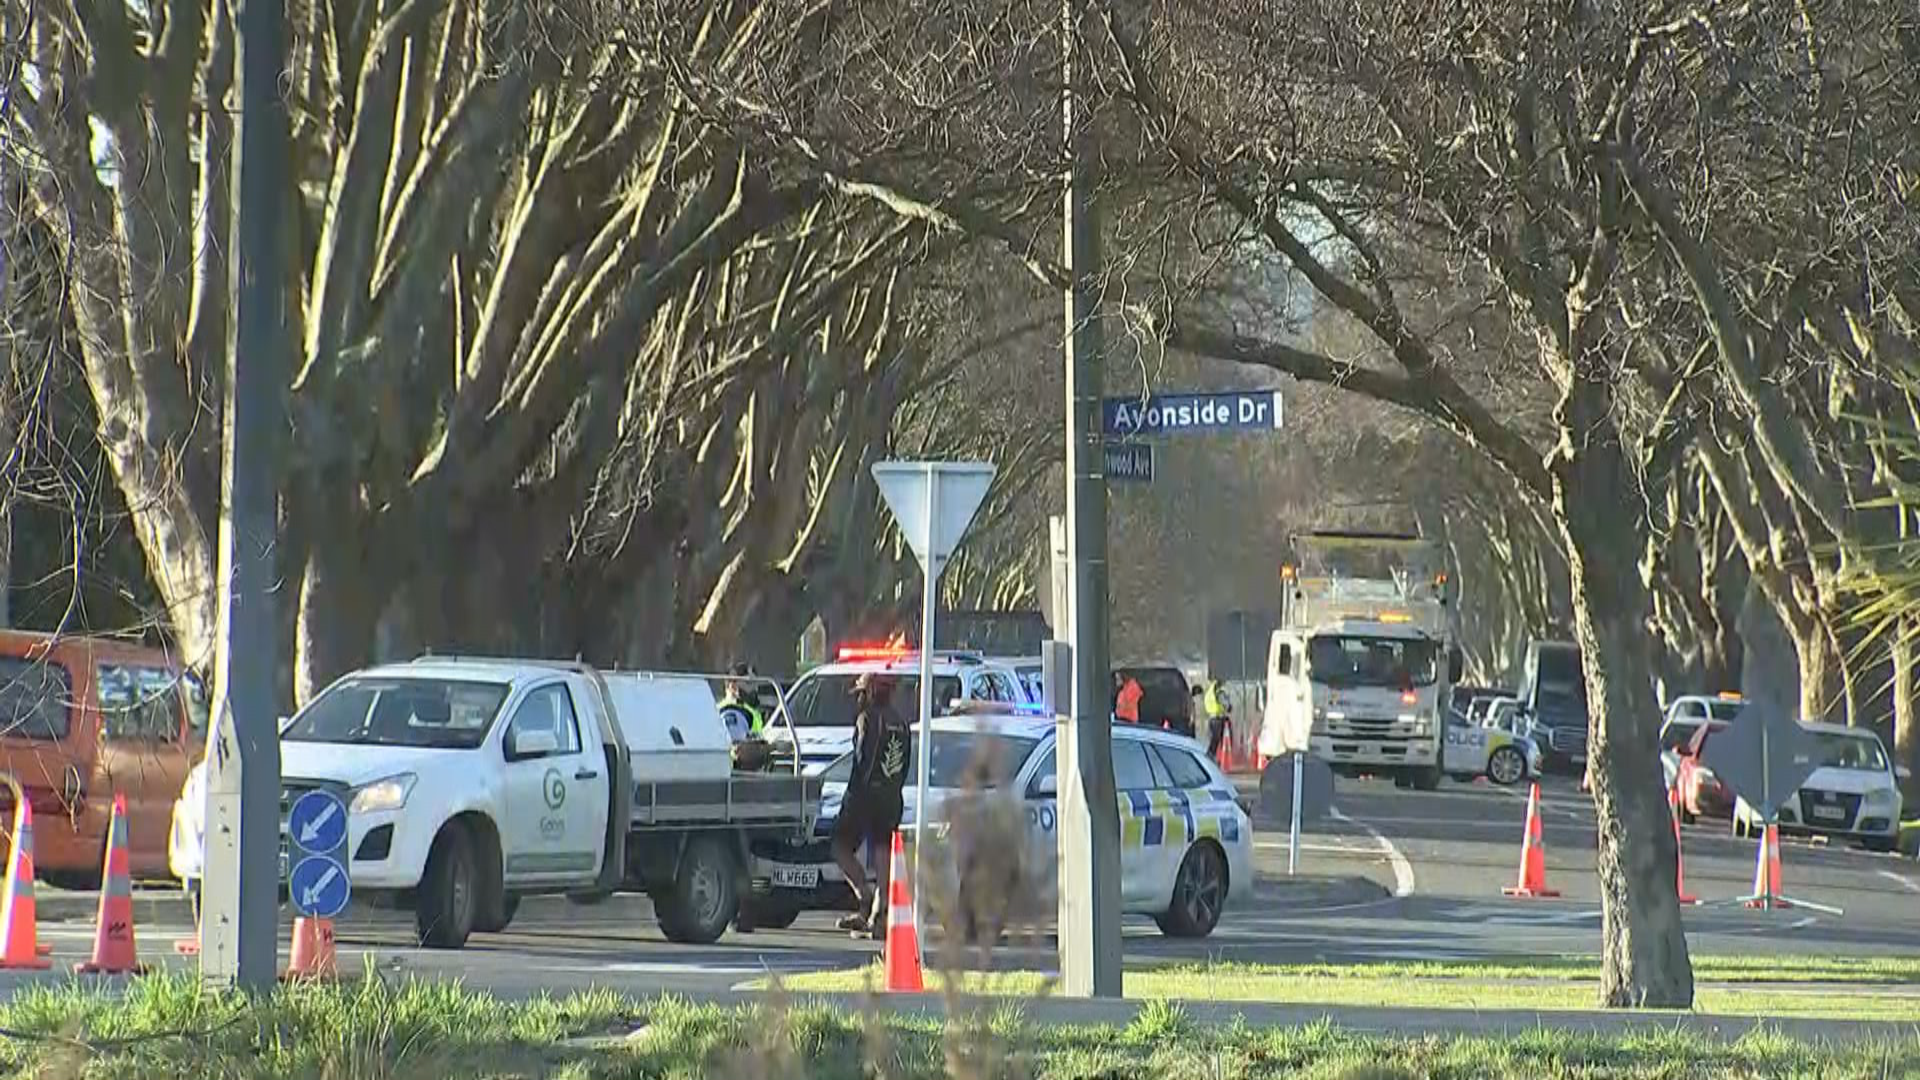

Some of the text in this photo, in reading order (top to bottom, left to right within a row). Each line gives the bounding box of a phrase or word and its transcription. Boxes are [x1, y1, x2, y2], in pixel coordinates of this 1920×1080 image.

[1114, 396, 1268, 428] Avonside Dr
[1446, 731, 1486, 747] OLICE
